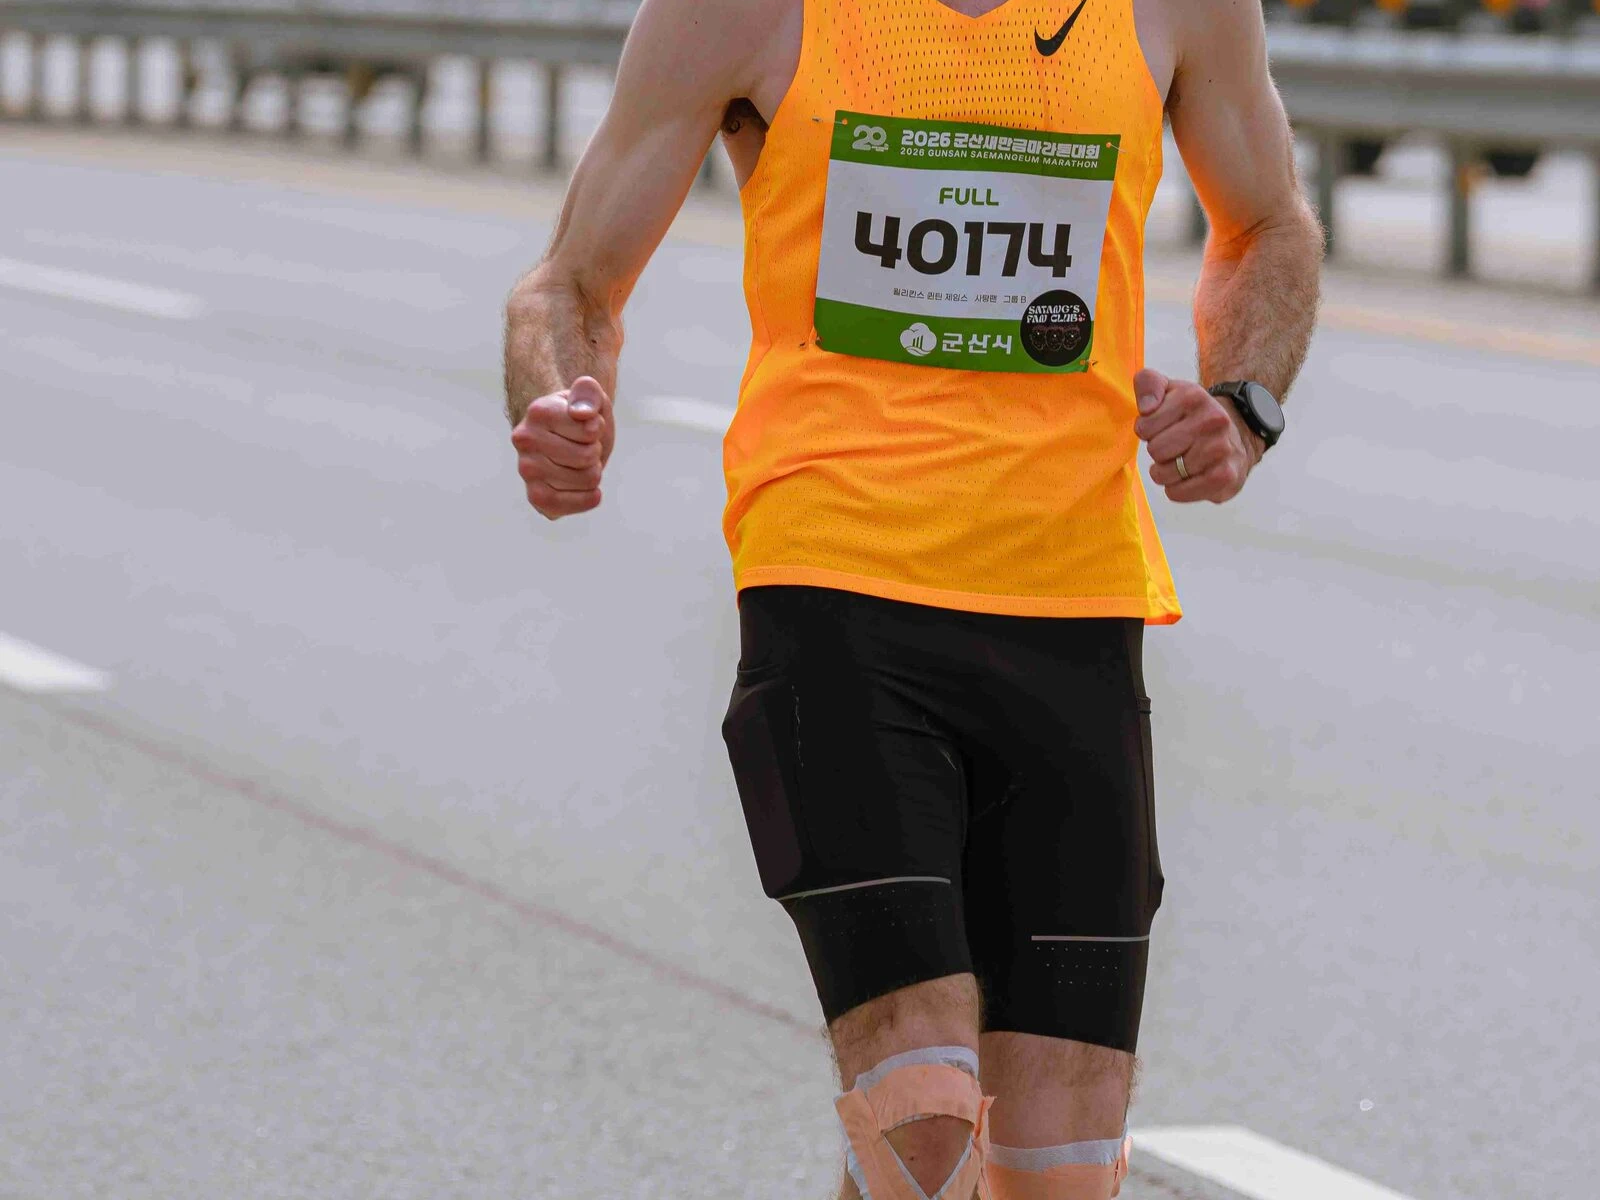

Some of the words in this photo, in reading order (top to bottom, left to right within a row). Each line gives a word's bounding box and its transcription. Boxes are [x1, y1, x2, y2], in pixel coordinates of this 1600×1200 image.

[901, 129, 951, 148] 2026
[953, 132, 1101, 160] 군산새만금마라톤대회
[900, 147, 925, 157] 2026
[928, 148, 968, 158] GUNSAN
[970, 150, 1040, 164] SAEMANGEUM
[1042, 156, 1099, 169] MARATHON
[938, 187, 1000, 206] FULL
[854, 211, 1073, 278] 40174
[945, 292, 968, 302] 제임스
[1003, 294, 1019, 304] 그룹
[1020, 295, 1027, 304] B
[1026, 314, 1048, 324] FAN
[1050, 313, 1078, 323] CLUB
[1028, 304, 1080, 315] SATANG'S
[942, 332, 1013, 355] 군산시
